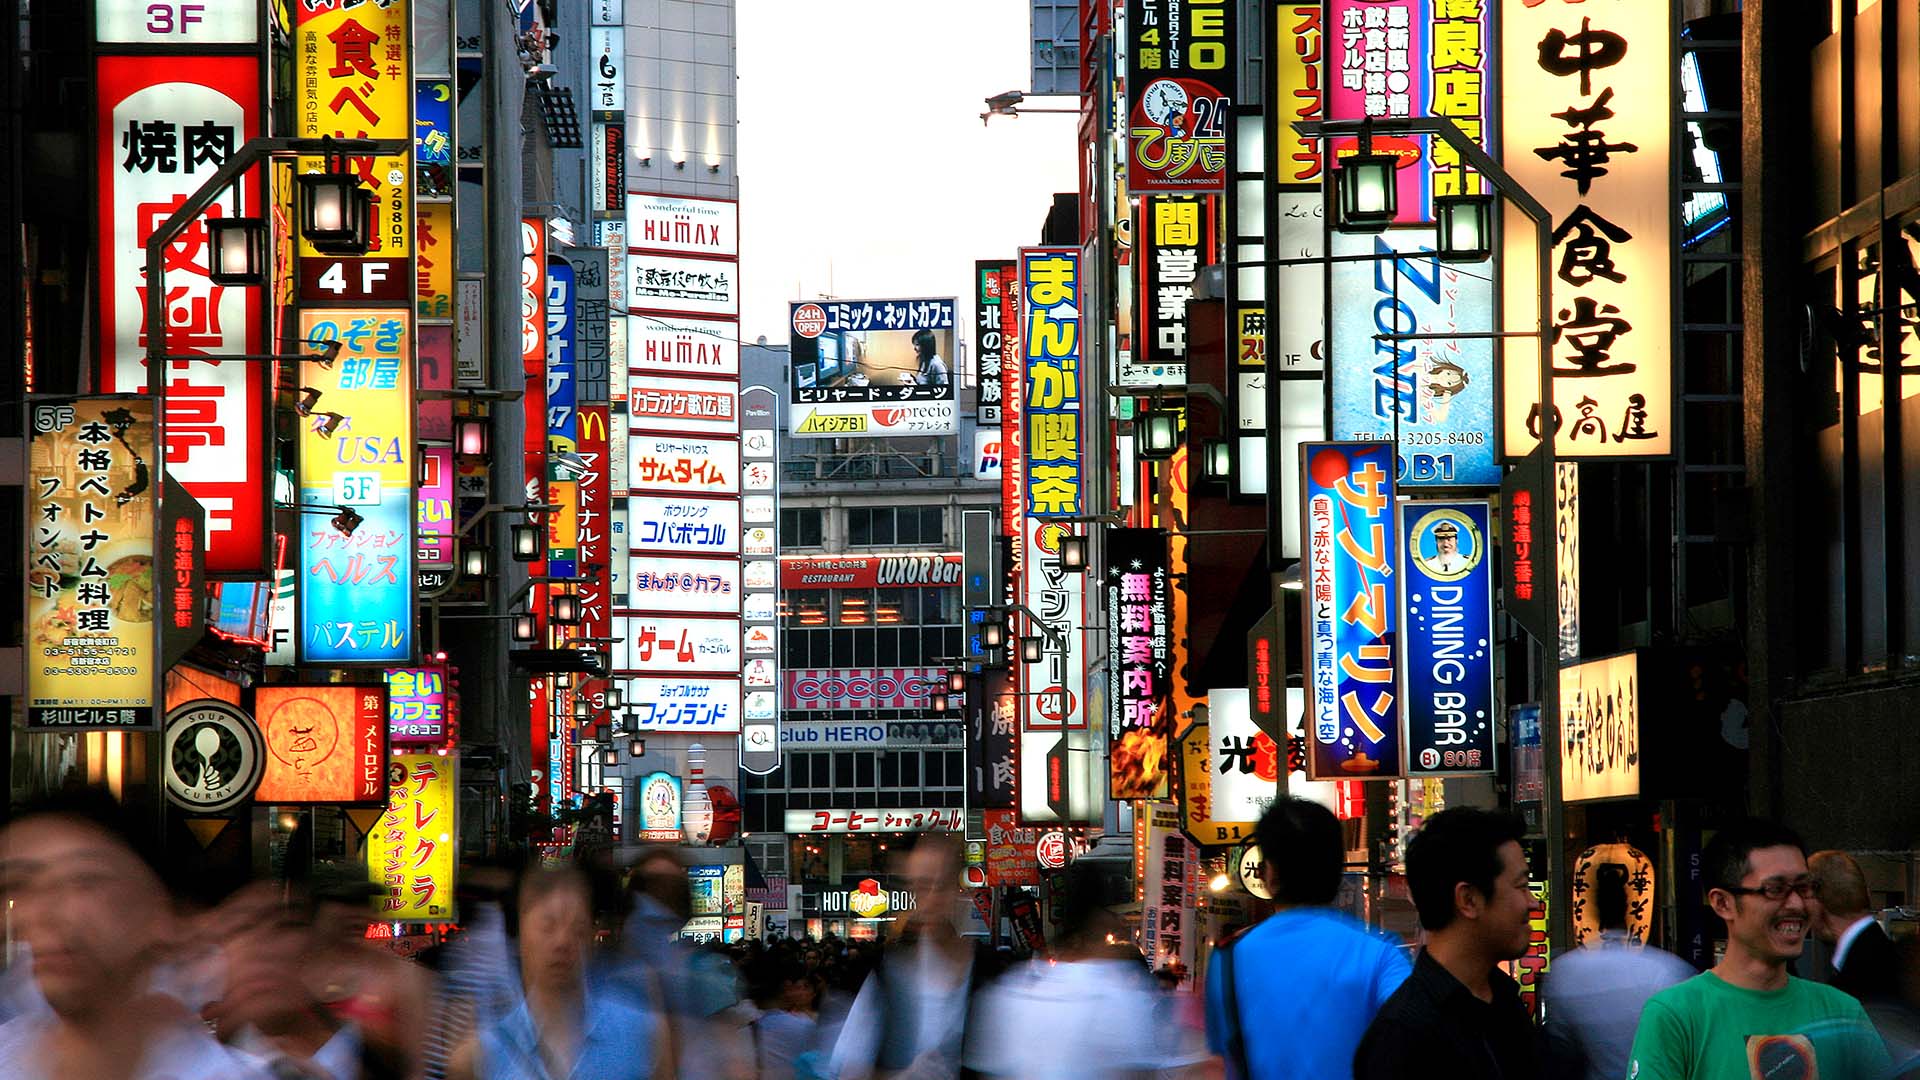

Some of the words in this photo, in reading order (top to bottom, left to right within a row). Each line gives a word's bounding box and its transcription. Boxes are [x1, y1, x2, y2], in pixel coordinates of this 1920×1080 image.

[147, 4, 204, 34] 3F
[1168, 0, 1180, 69] AGAZINE
[1187, 0, 1226, 70] EO
[1341, 7, 1364, 91] ホテル可
[305, 31, 318, 134] 高級な雰囲気の店内
[122, 121, 235, 174] 焼肉
[643, 203, 696, 214] wonderful
[697, 208, 720, 216] time
[1532, 17, 1640, 378] 中華食堂
[390, 188, 403, 247] 2980円
[607, 222, 623, 232] 3F
[644, 214, 720, 246] HUMAX
[318, 262, 390, 295] 4F
[798, 308, 821, 320] 24H
[798, 321, 821, 333] OPEN
[827, 302, 953, 330] コミック・ネットカフェ
[307, 317, 404, 353] のぞき
[1374, 236, 1441, 425] ZONE
[646, 335, 722, 366] HUMAX
[979, 305, 1003, 403] 北の家族
[1285, 354, 1301, 366] 1F
[338, 357, 403, 391] 部屋
[1028, 257, 1078, 514] まんが喫茶
[633, 391, 733, 418] カラオケ歌広場
[799, 385, 949, 402] ビリヤード・ダーツ
[34, 405, 76, 432] 5F
[807, 415, 866, 432] ハイジアB1
[336, 436, 405, 464] USA
[655, 442, 709, 456] ビリヤードハウス
[638, 456, 727, 486] サムタイム
[342, 476, 374, 501] 5F
[664, 504, 710, 519] ボウリング
[39, 477, 62, 602] フォンベト
[77, 420, 112, 633] 本格ベトナム料理
[310, 529, 405, 549] ファッション
[640, 520, 727, 546] コパボウル
[310, 550, 400, 586] ヘルス
[801, 573, 857, 584] RESTAURANT
[877, 558, 930, 585] LUXOR
[931, 557, 961, 583] Bar
[1332, 461, 1396, 745] サブマリン
[1310, 497, 1338, 743] 真っ赤な太陽と真っ青な海と空
[310, 619, 406, 651] パステル
[638, 625, 696, 664] ゲーム
[1430, 586, 1466, 686] DINING
[1120, 572, 1152, 728] 無料案内所
[659, 683, 712, 698] ジョイフルサウナ
[794, 676, 900, 702] COCO
[40, 708, 137, 726] 杉山ビル5階
[188, 712, 226, 724] SOUP
[641, 702, 728, 725] フィンランド
[1433, 691, 1467, 747] BAR
[362, 694, 380, 796] 第一メトロビル
[781, 726, 819, 742] club
[824, 726, 885, 742] HERO
[1422, 751, 1438, 767] B1
[1443, 749, 1483, 769] 80席
[183, 784, 233, 801] CURRY
[410, 761, 440, 910] テレクラ
[1216, 826, 1243, 841] B1
[822, 890, 849, 912] HOT
[891, 889, 918, 911] BOX
